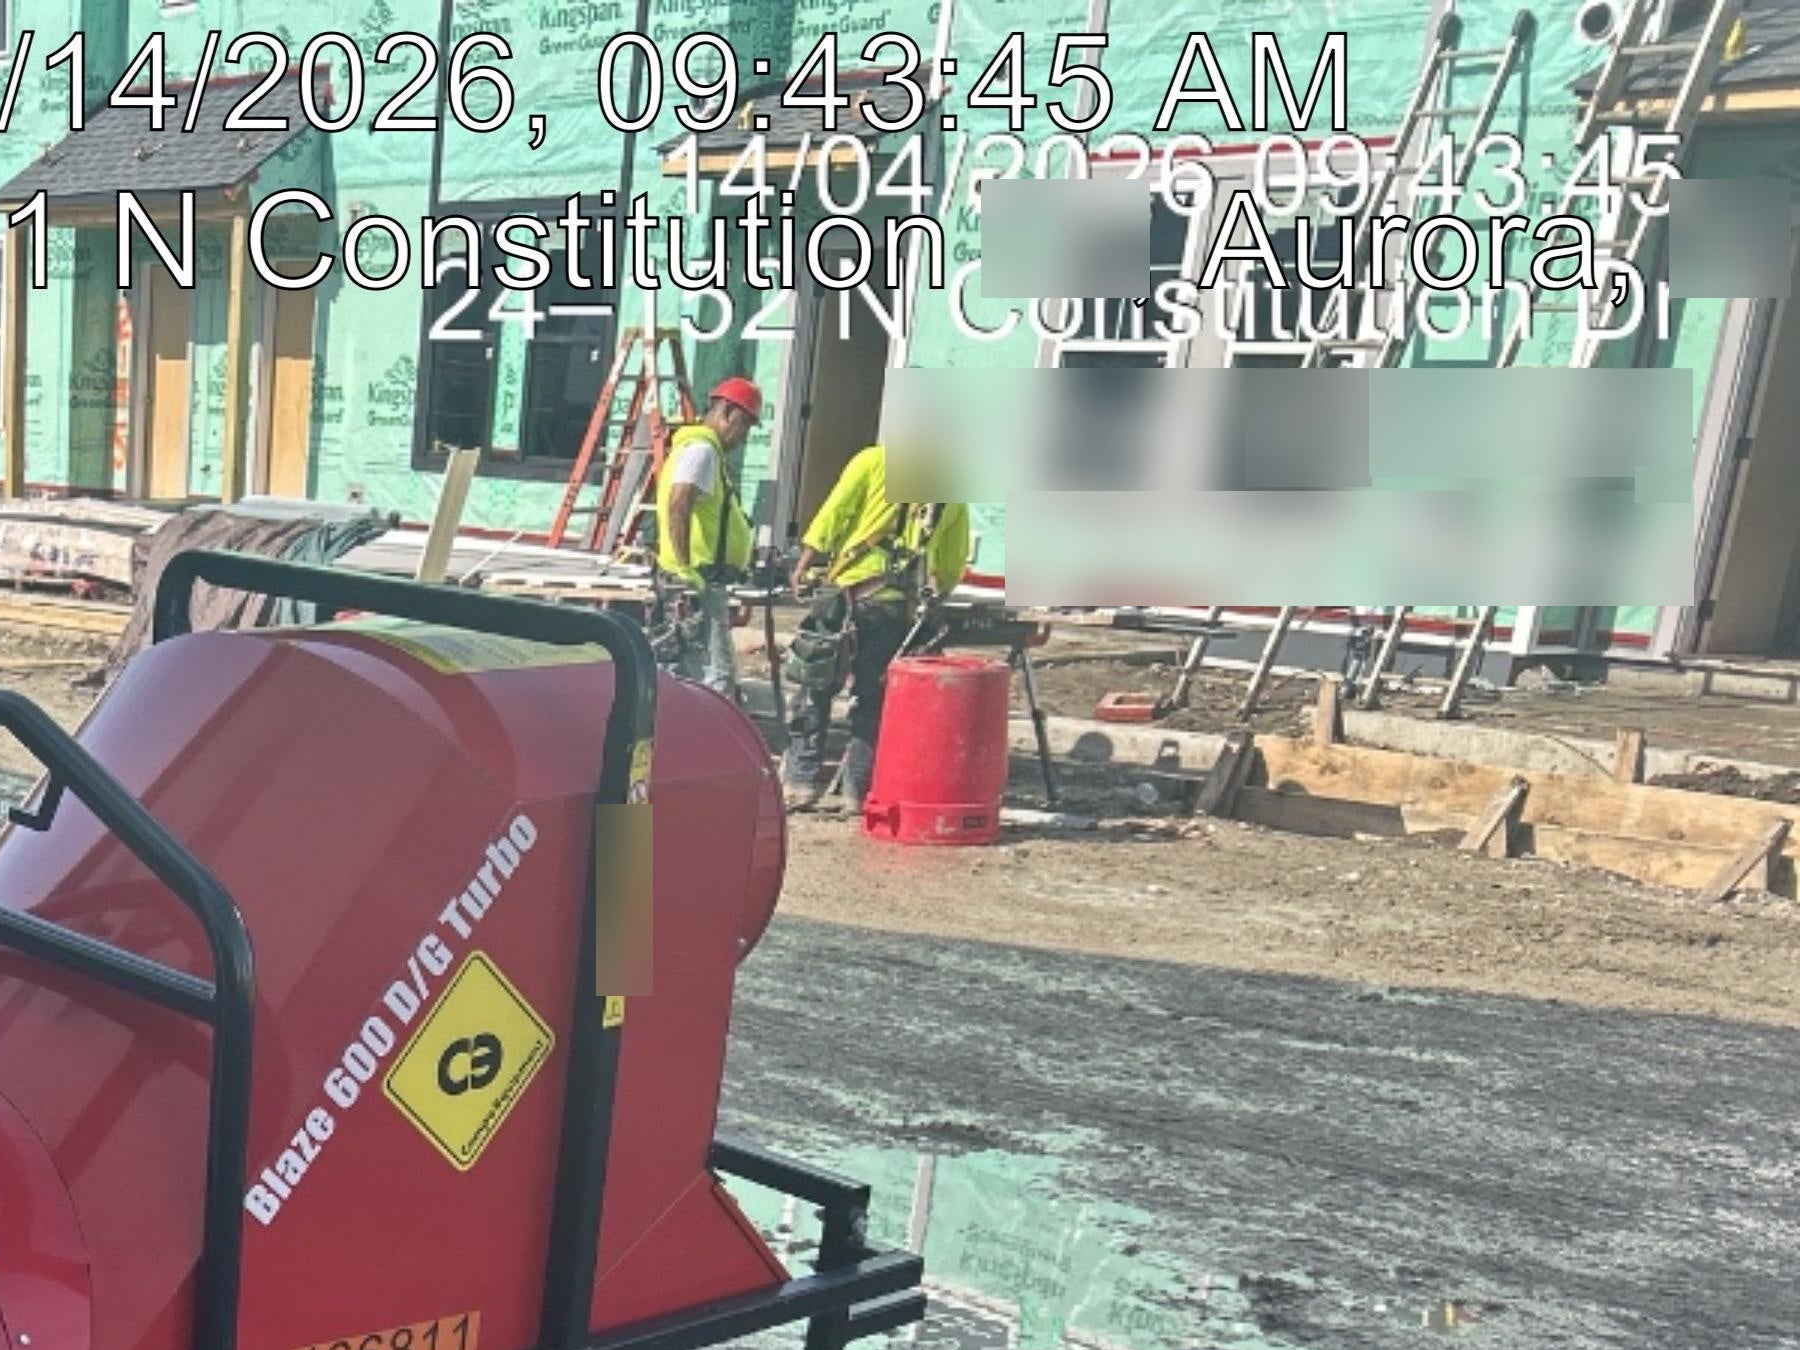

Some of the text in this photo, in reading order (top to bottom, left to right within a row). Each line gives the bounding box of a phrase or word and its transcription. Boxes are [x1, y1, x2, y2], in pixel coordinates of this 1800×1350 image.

[243, 813, 539, 1226] Blaze 600 D/G Turbo
